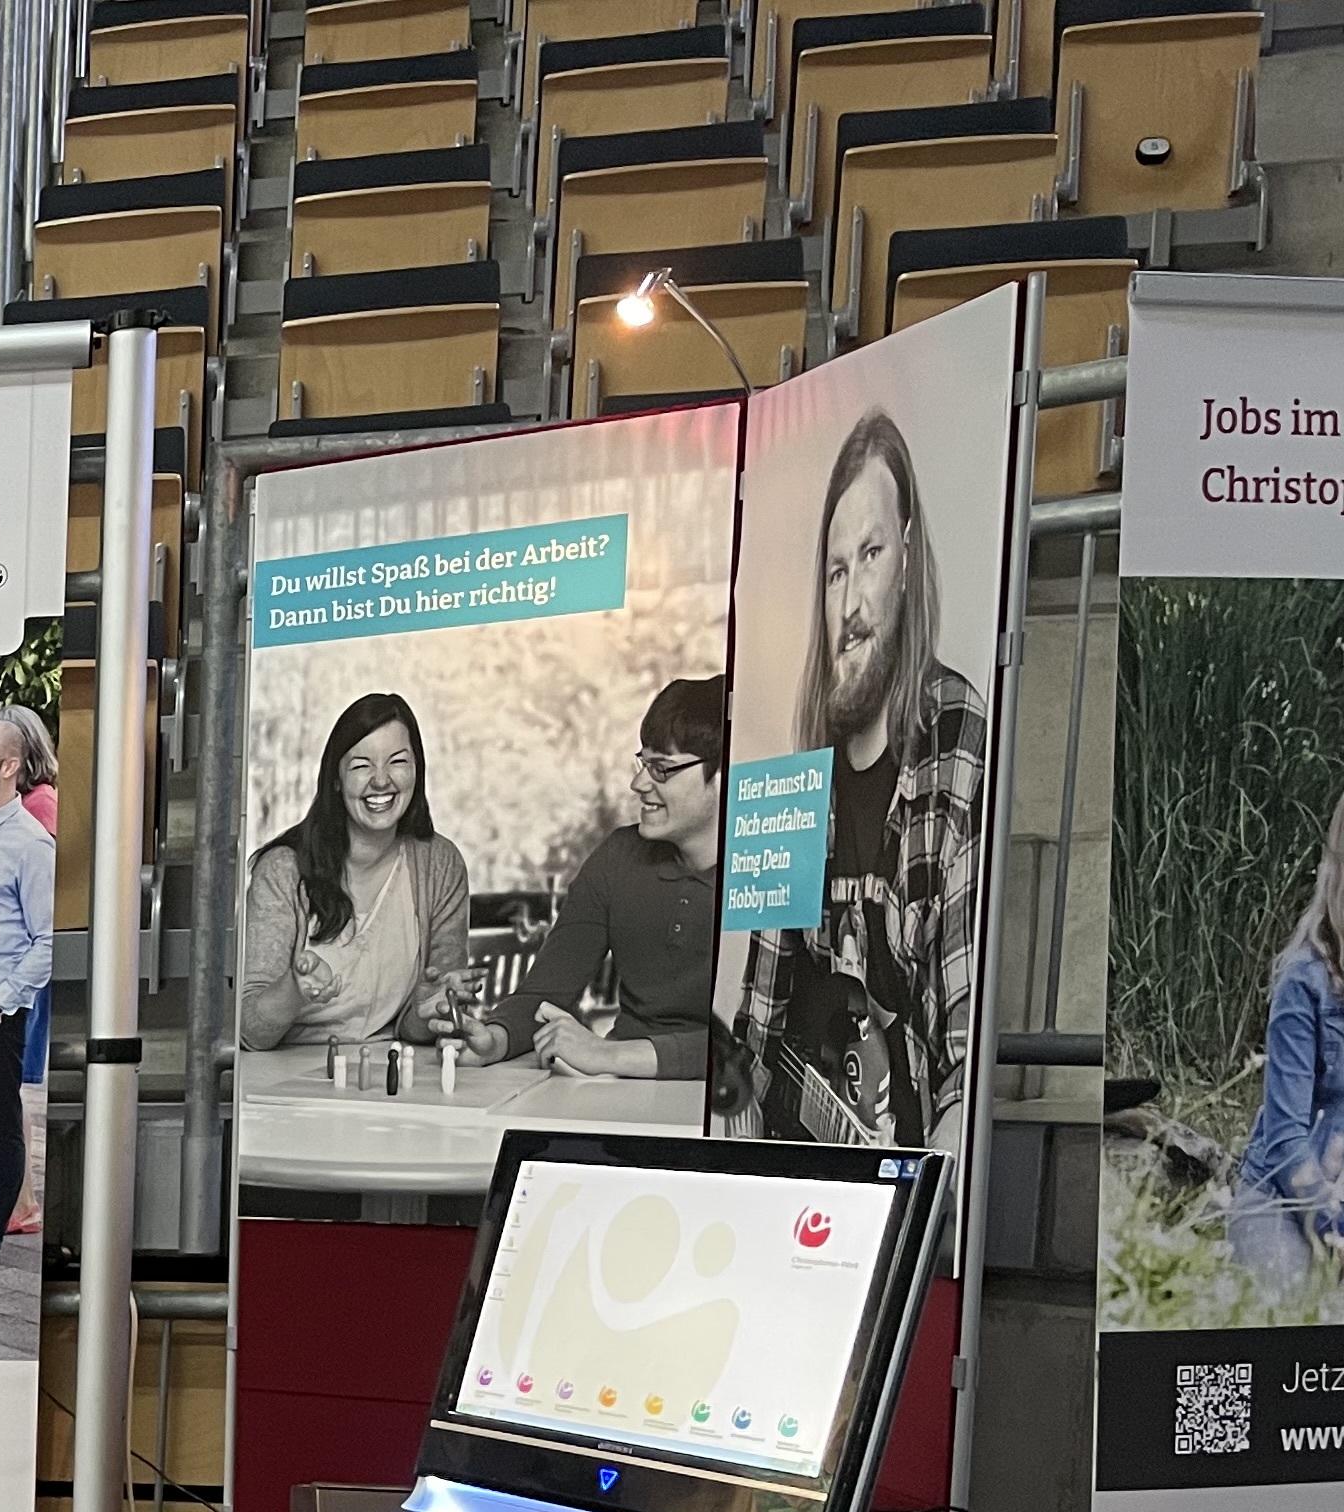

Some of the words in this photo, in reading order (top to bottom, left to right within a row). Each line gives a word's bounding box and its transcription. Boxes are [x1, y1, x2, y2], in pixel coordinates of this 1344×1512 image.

[1200, 396, 1281, 440] Jobs
[1291, 398, 1341, 436] im
[1201, 465, 1344, 516] Christo
[270, 575, 301, 596] Du
[307, 566, 366, 592] willst
[371, 556, 430, 589] Spaß
[435, 554, 471, 577] bei
[475, 547, 517, 572] der
[520, 534, 610, 566] Arbeit?
[269, 608, 327, 629] Dann
[332, 599, 374, 623] bist
[379, 595, 411, 617] Du
[417, 589, 464, 612] hier
[468, 576, 557, 607] richtig!
[738, 777, 765, 801] Hier
[765, 772, 805, 798] kannst
[807, 768, 823, 792] Du
[734, 811, 760, 838] Dich
[731, 849, 761, 878] Bring
[762, 846, 791, 871] Dein
[728, 884, 767, 914] Hobby
[767, 882, 790, 907] mit!
